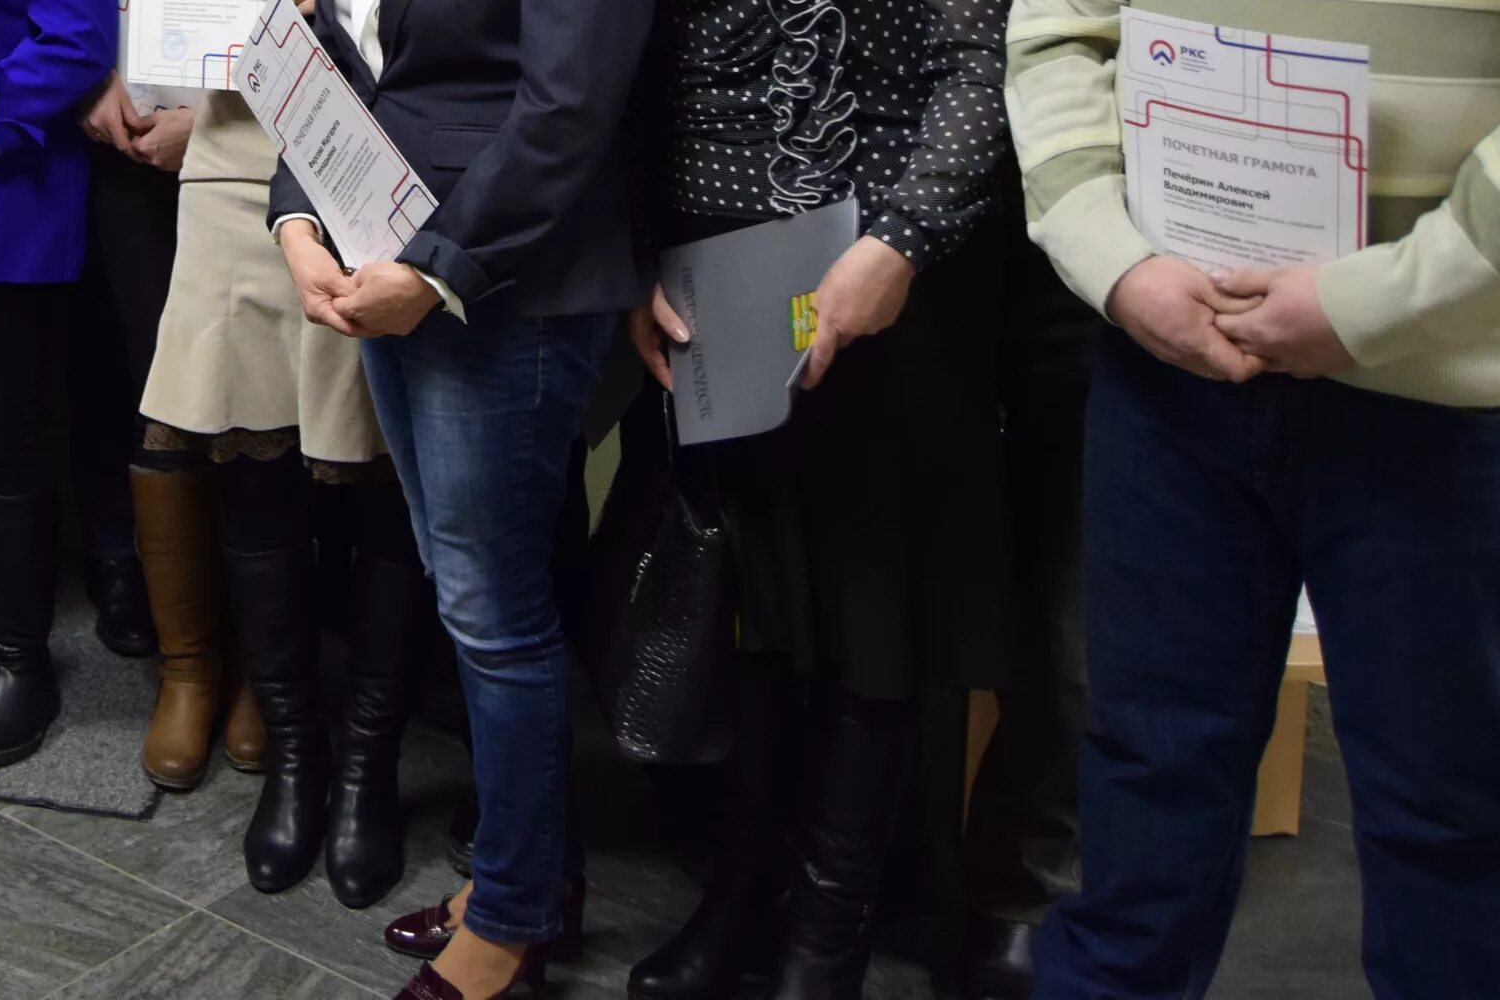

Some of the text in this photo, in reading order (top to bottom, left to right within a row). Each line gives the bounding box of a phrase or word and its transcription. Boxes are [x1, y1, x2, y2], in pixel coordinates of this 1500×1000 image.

[1180, 46, 1206, 60] РКС
[293, 87, 332, 149] ПОЧЕТНАЯ ГРАМОТА
[1162, 136, 1318, 179] ПОЧЕТНАЯ ГРАМОТА
[1163, 180, 1254, 211] Владимирович
[1217, 181, 1271, 200] Алексей
